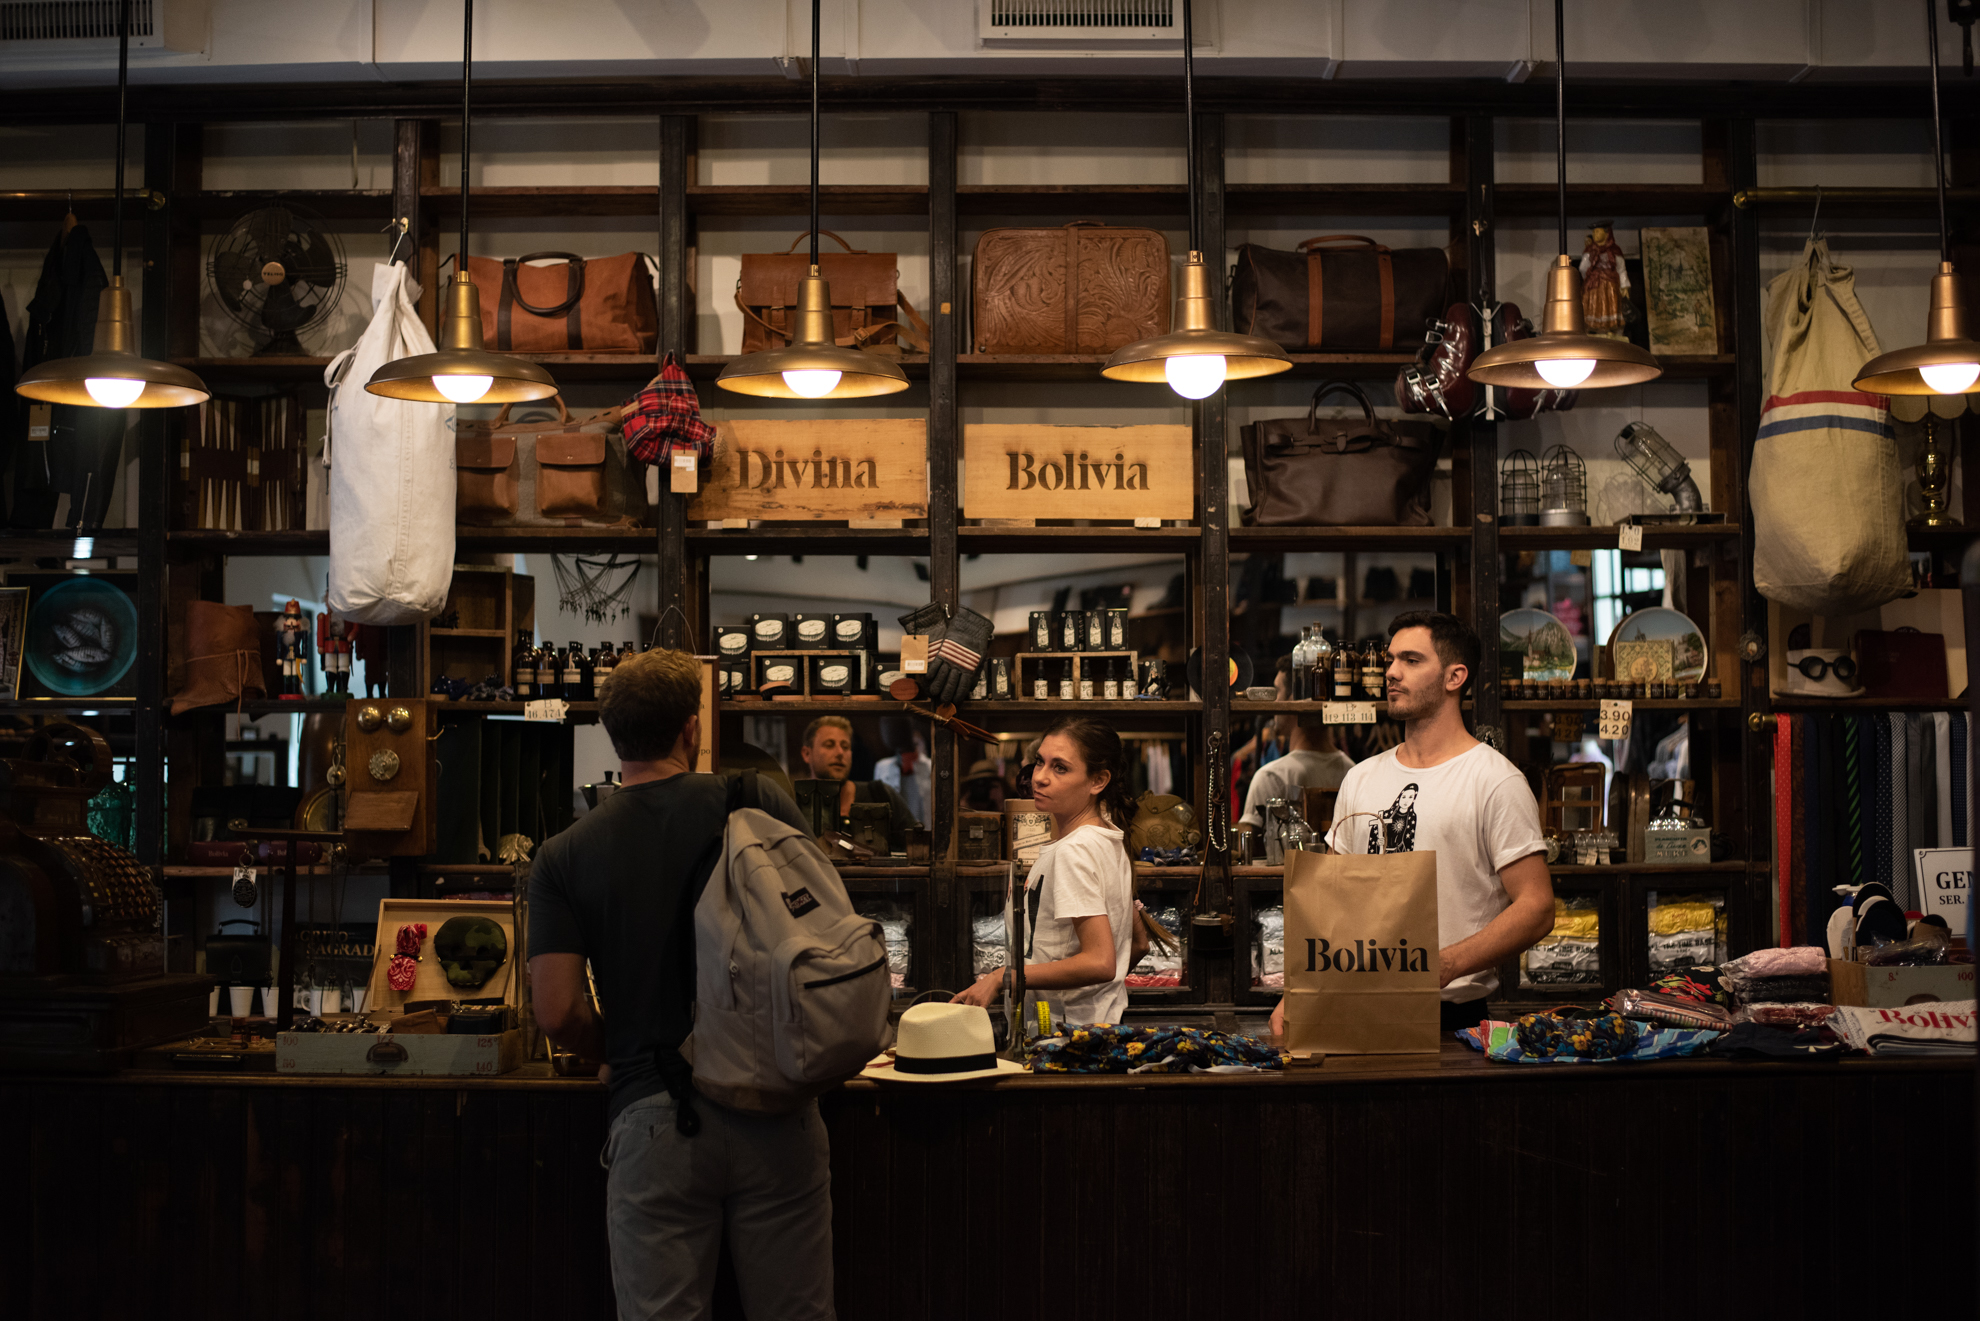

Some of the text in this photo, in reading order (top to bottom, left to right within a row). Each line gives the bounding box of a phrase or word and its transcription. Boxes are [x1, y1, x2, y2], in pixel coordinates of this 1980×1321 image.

[735, 449, 879, 490] Divina
[1006, 452, 1150, 491] Bolivia
[1324, 713, 1339, 722] 112
[1342, 713, 1356, 722] 113
[1600, 710, 1631, 721] 3.90
[1600, 724, 1629, 736] 4.20
[1939, 894, 1965, 906] SER.
[306, 943, 375, 957] SAGRAD
[1304, 938, 1430, 972] Bolivia
[1957, 972, 1974, 981] 100
